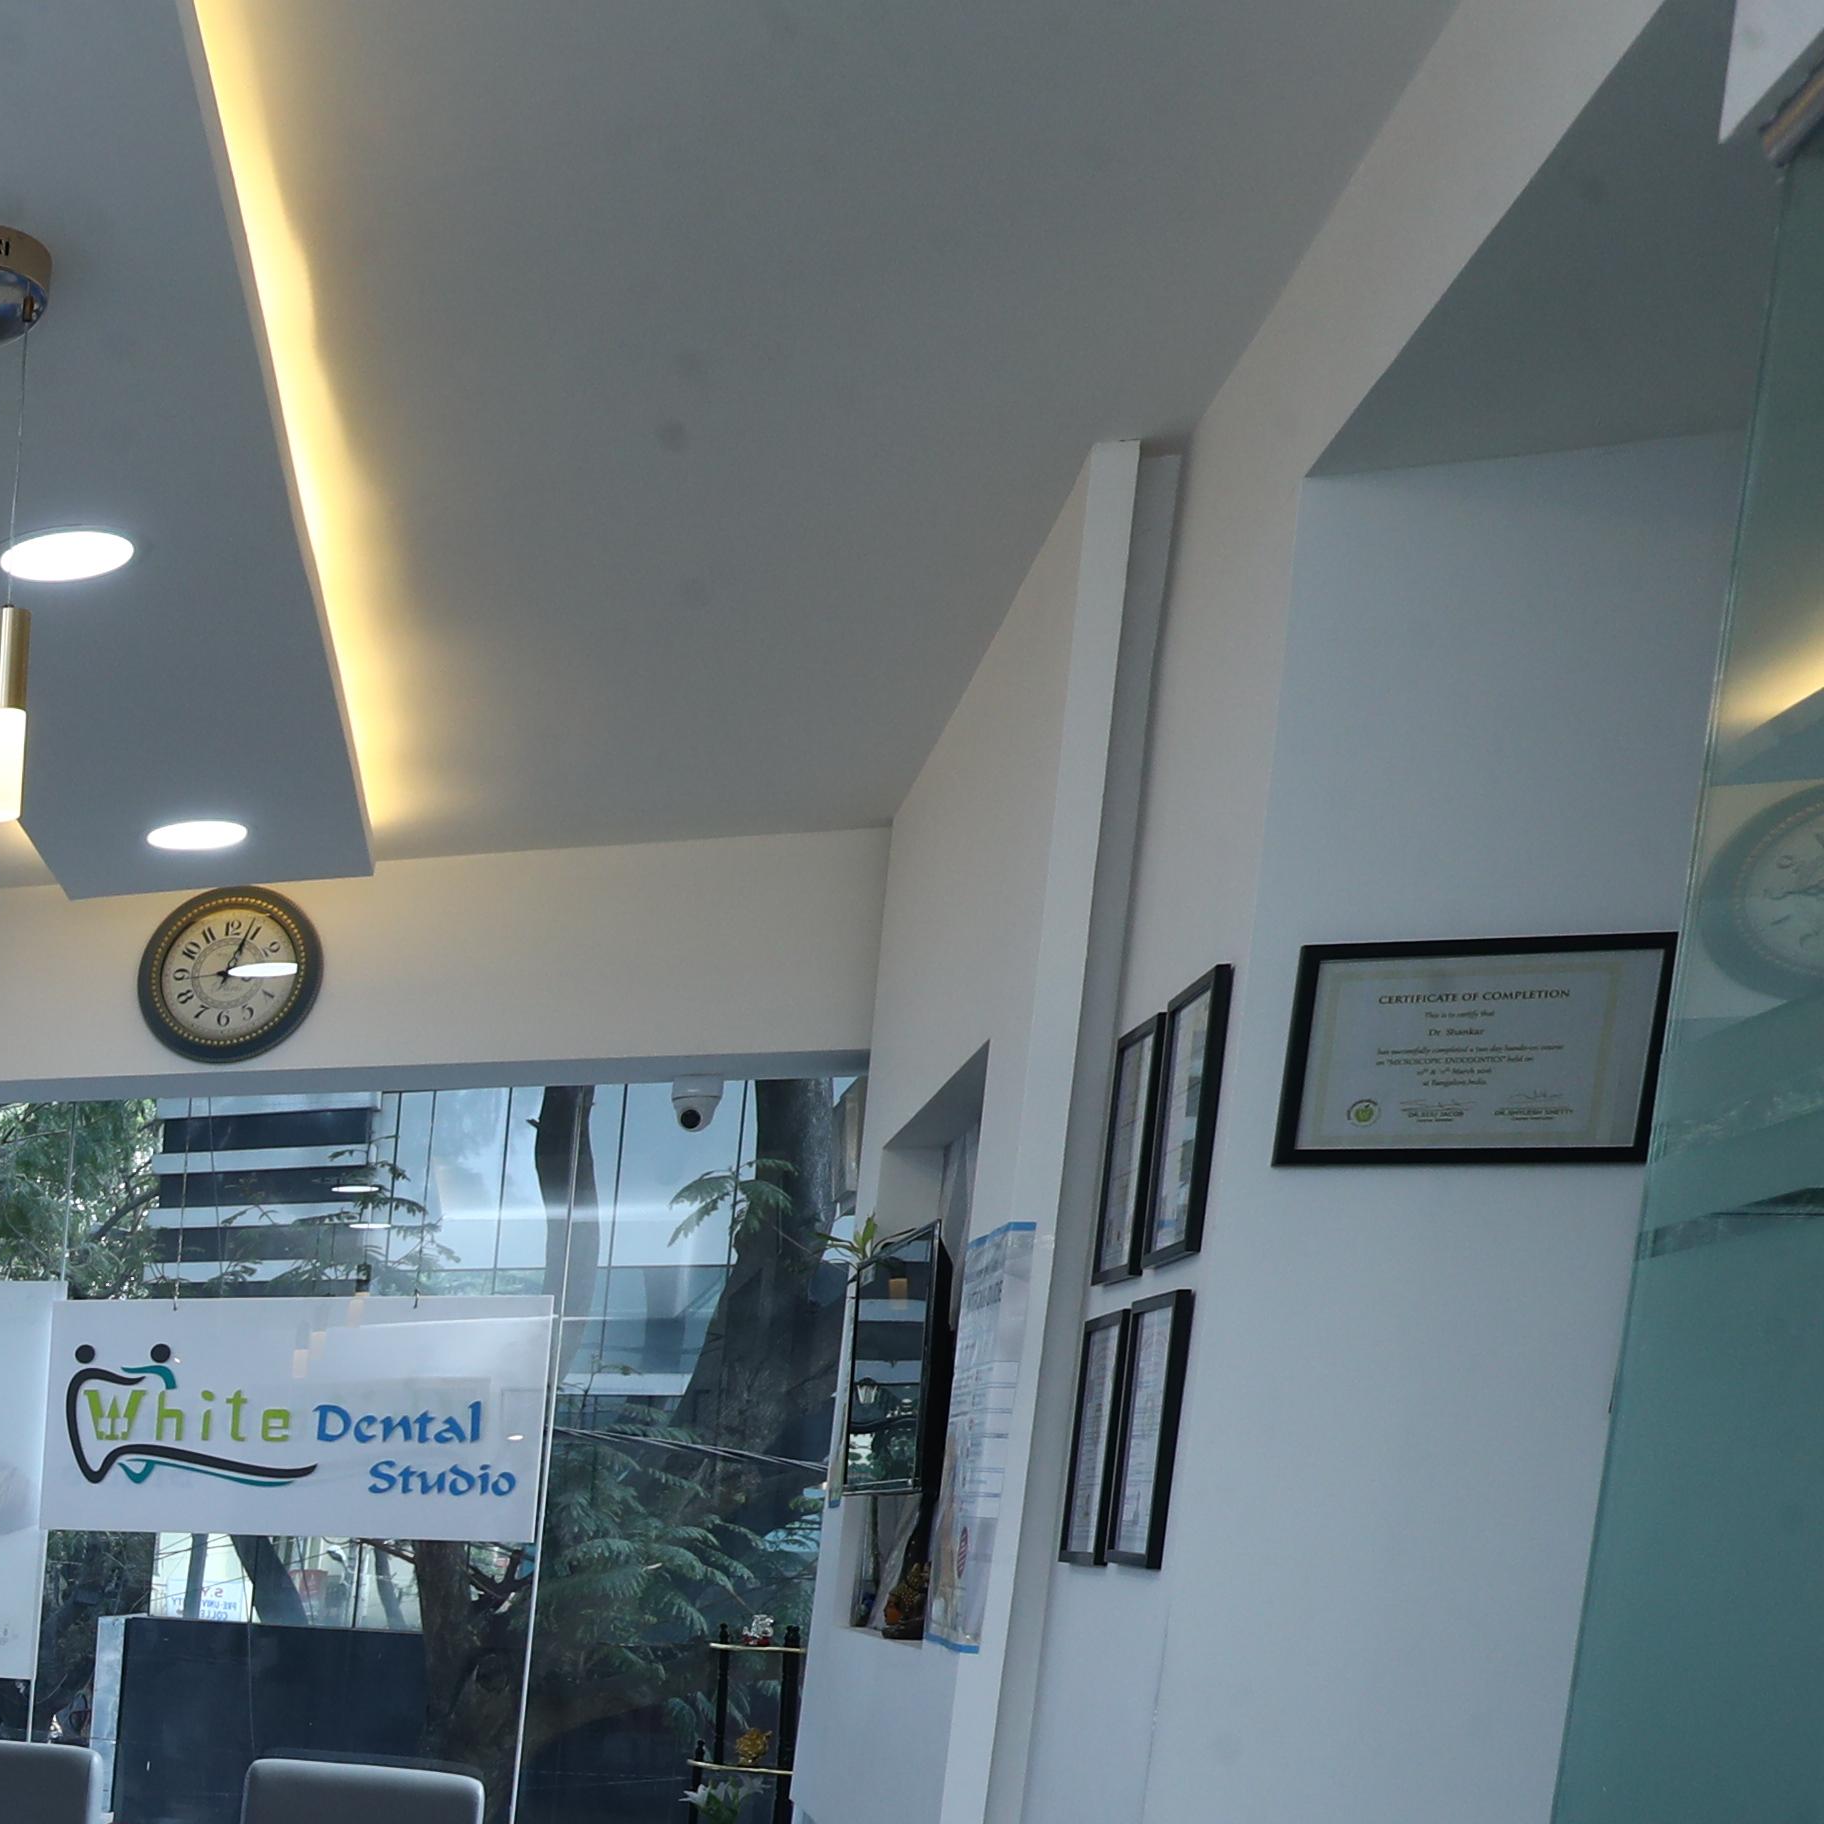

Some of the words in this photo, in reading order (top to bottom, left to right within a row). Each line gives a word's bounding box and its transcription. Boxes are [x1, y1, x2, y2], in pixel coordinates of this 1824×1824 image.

[224, 919, 242, 937] 12
[1378, 991, 1457, 1005] CERTIFICATE
[1461, 991, 1477, 1002] OF
[1482, 988, 1571, 1001] COMPLETION
[216, 1010, 230, 1027] 6
[83, 1388, 291, 1442] White
[314, 1399, 483, 1445] Dental
[368, 1459, 518, 1498] Studio
